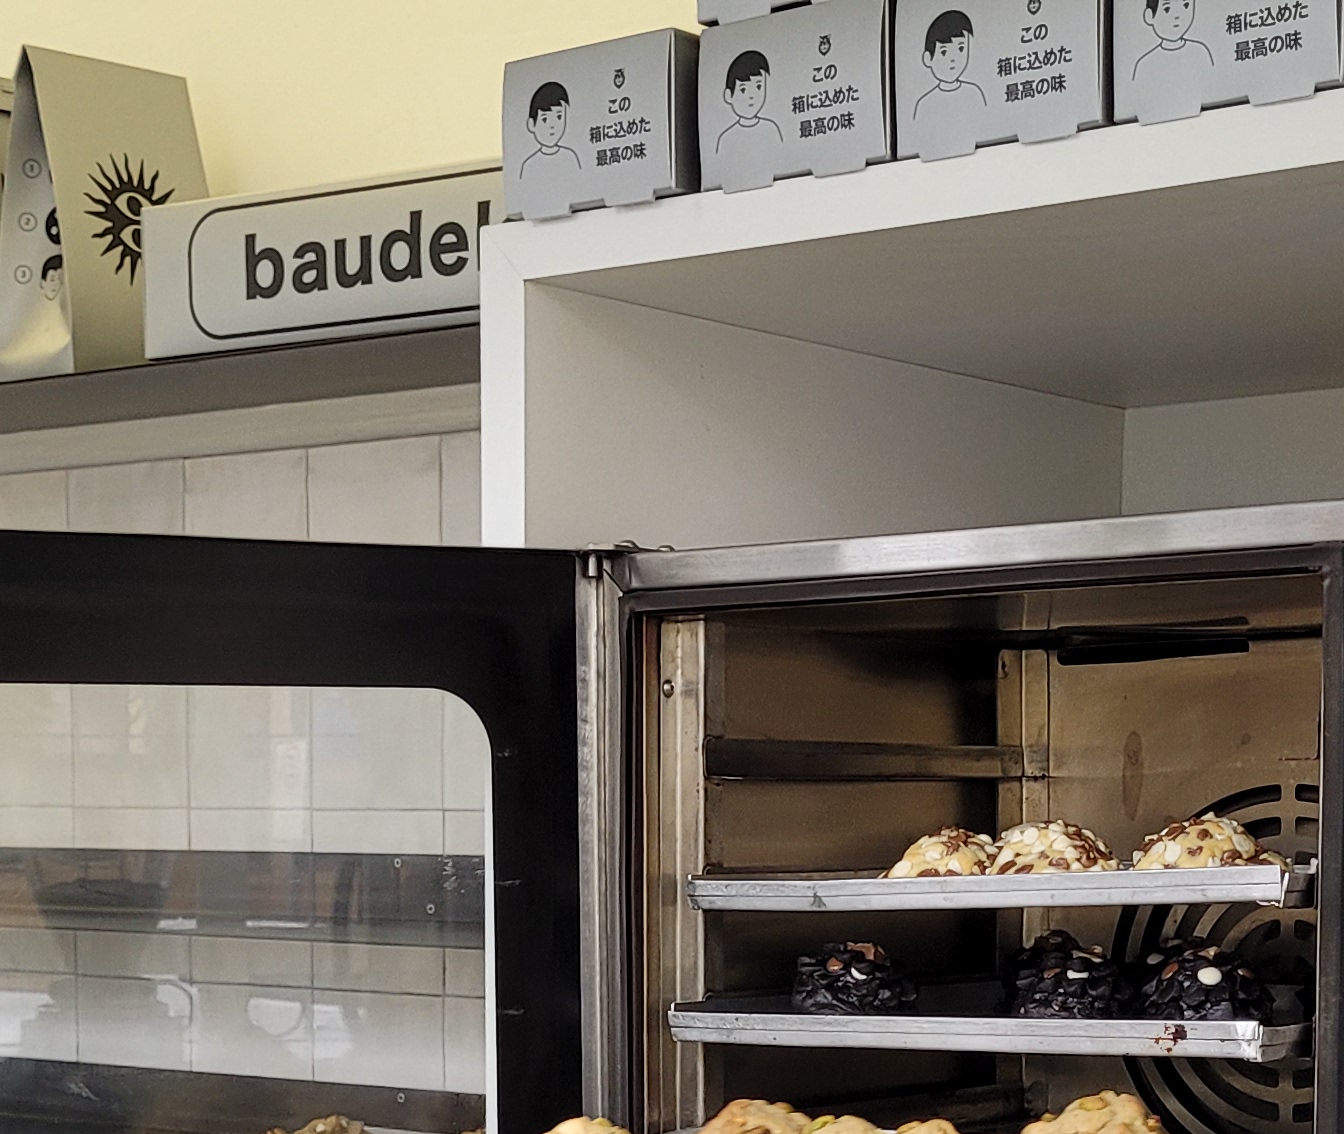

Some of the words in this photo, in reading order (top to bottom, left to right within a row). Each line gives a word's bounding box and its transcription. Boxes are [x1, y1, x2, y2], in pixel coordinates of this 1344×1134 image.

[1225, 0, 1309, 35] 箱に込めた
[1020, 23, 1049, 44] この
[1234, 30, 1303, 61] 最高の味
[812, 64, 838, 83] この
[996, 45, 1073, 78] 箱に込めた
[791, 85, 860, 114] 箱に込めた
[1004, 73, 1067, 103] 最高の味
[608, 96, 632, 115] この
[589, 117, 652, 144] 箱に込めた
[799, 111, 855, 138] 最高の味
[596, 142, 647, 167] 最高の味
